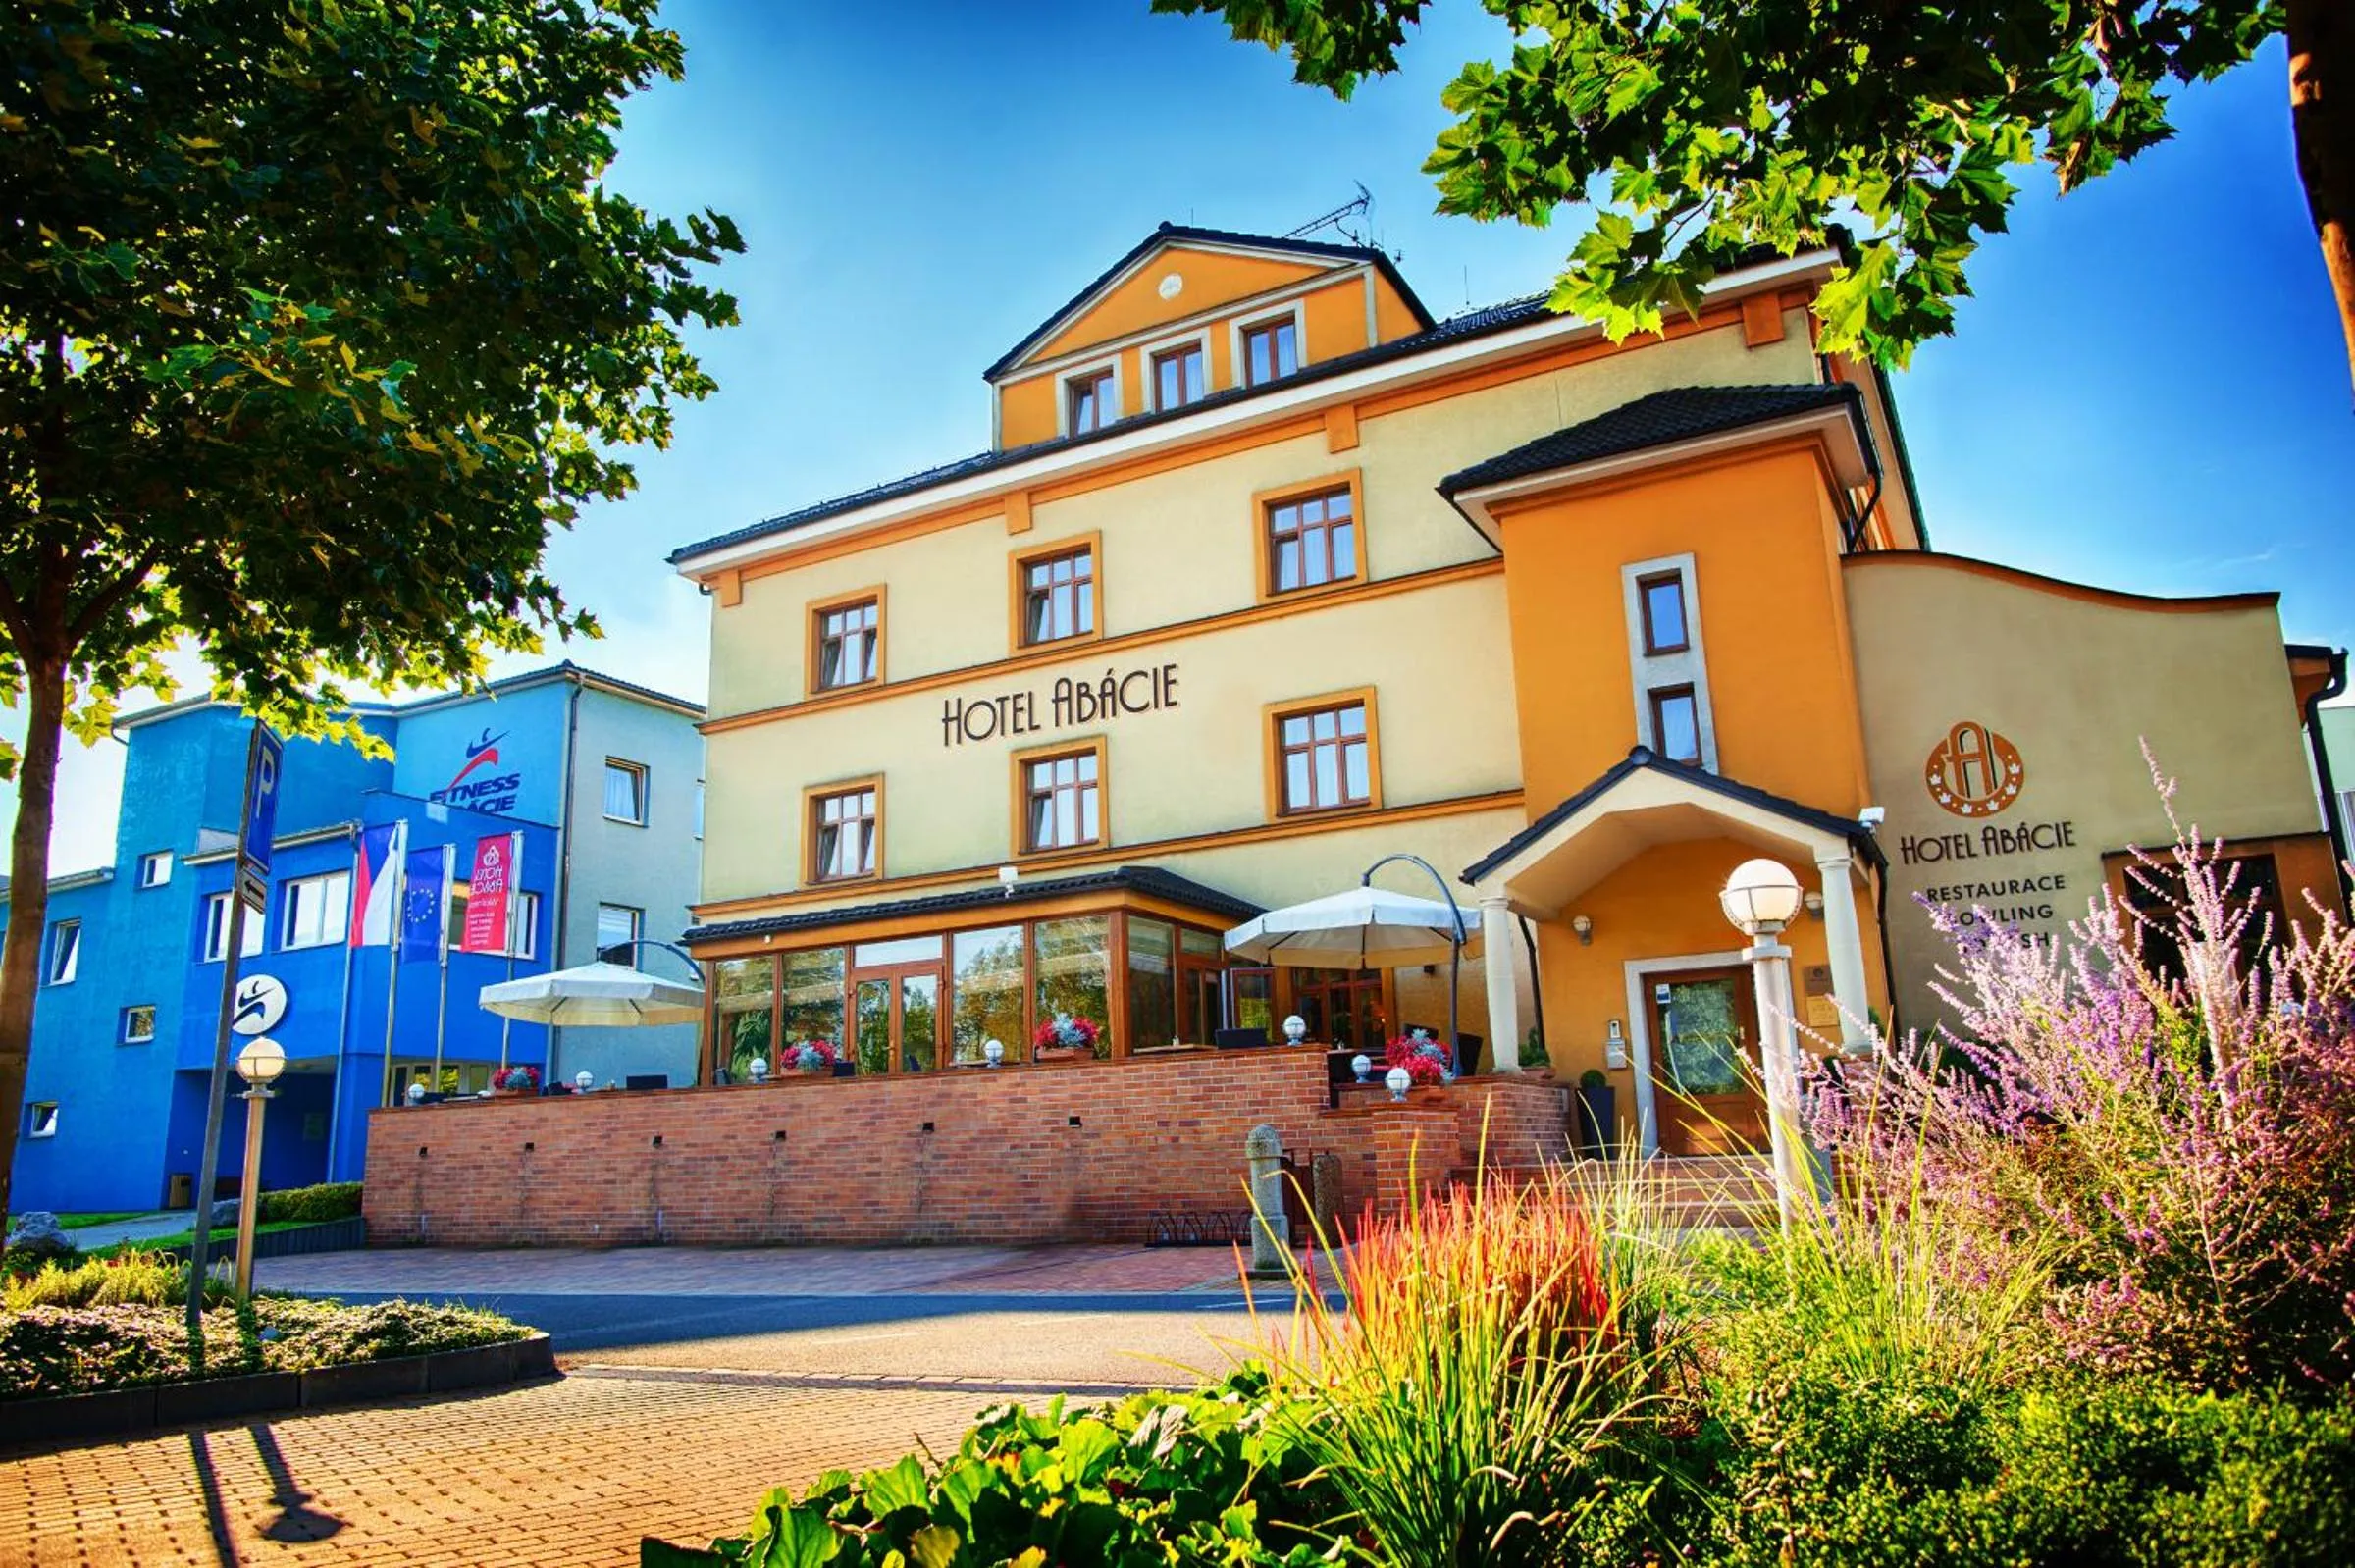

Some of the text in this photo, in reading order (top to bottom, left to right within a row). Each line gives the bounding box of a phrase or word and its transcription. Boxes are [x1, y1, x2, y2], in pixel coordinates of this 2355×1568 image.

[942, 663, 1179, 747] HOTEL ABÁCIE
[255, 745, 275, 819] P
[1900, 821, 2076, 865] HOTEL ABÁCIE
[1926, 874, 2067, 903] RESTAURACE
[1949, 904, 2054, 926] OLING
